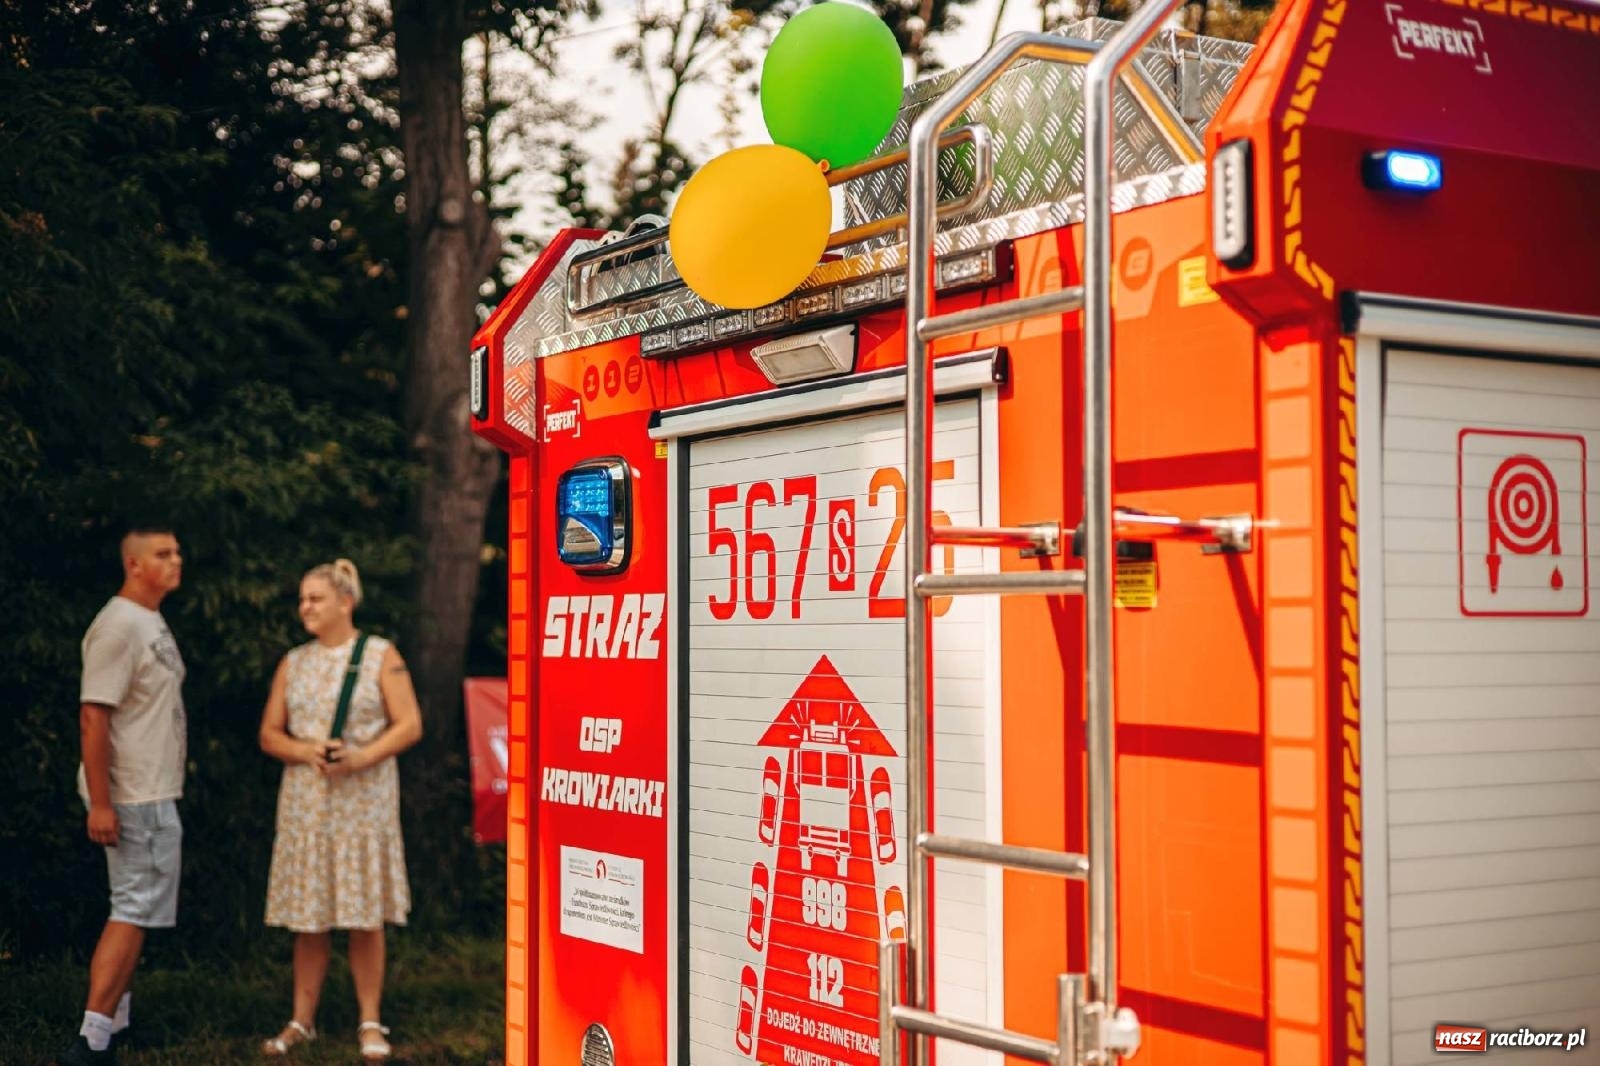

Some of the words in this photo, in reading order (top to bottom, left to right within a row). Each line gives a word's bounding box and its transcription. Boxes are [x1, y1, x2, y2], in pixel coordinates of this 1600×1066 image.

[1396, 18, 1477, 58] PERFEKT
[546, 409, 577, 433] PERFEKT
[708, 474, 817, 620] 567
[578, 716, 623, 754] OSP
[540, 766, 665, 818] KROWIARKI
[801, 877, 848, 932] 998
[806, 953, 845, 1008] 112
[803, 1017, 816, 1038] DO
